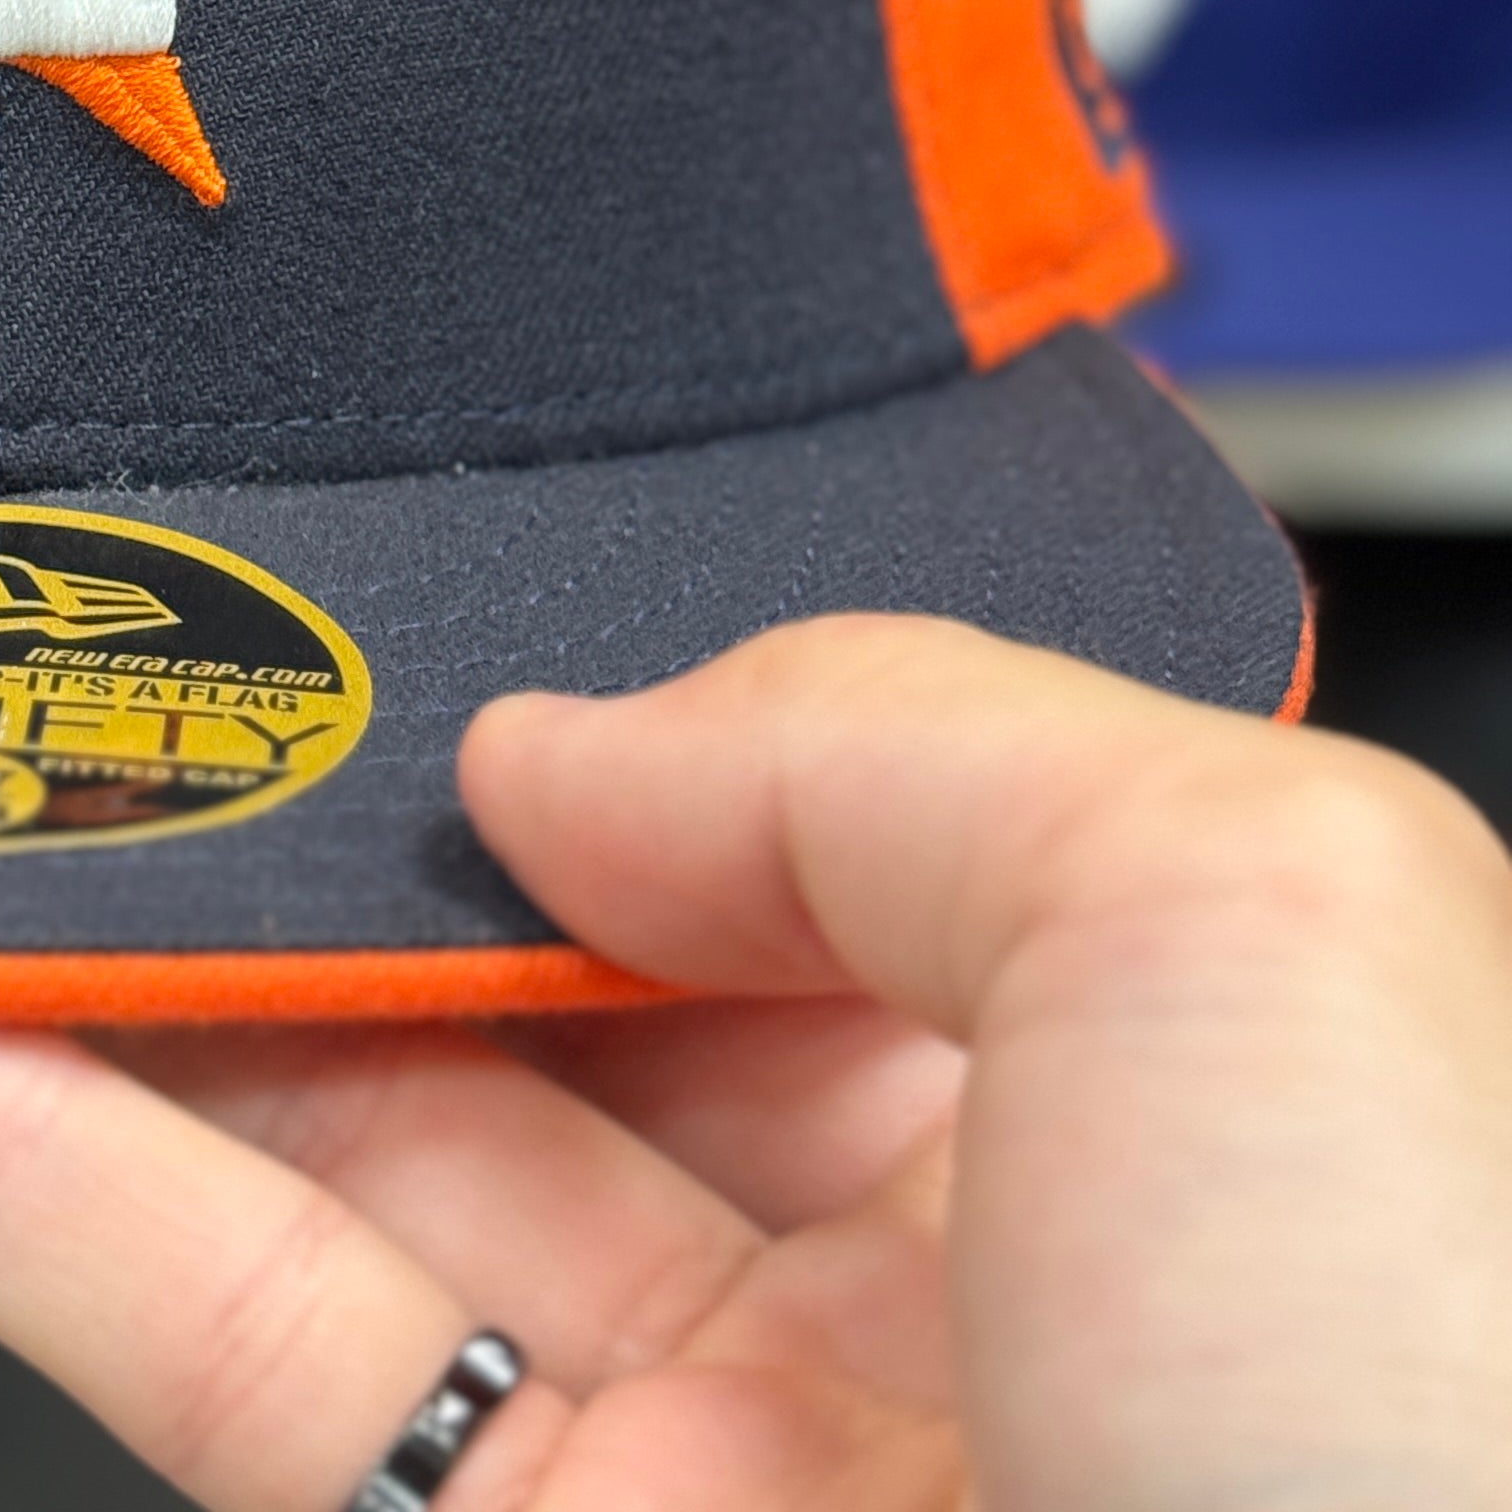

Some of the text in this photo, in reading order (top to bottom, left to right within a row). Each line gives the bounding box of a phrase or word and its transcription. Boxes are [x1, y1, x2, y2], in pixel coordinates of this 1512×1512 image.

[127, 679, 163, 701] A
[177, 683, 299, 713] FLAG
[38, 756, 261, 786] FITTED CAP
